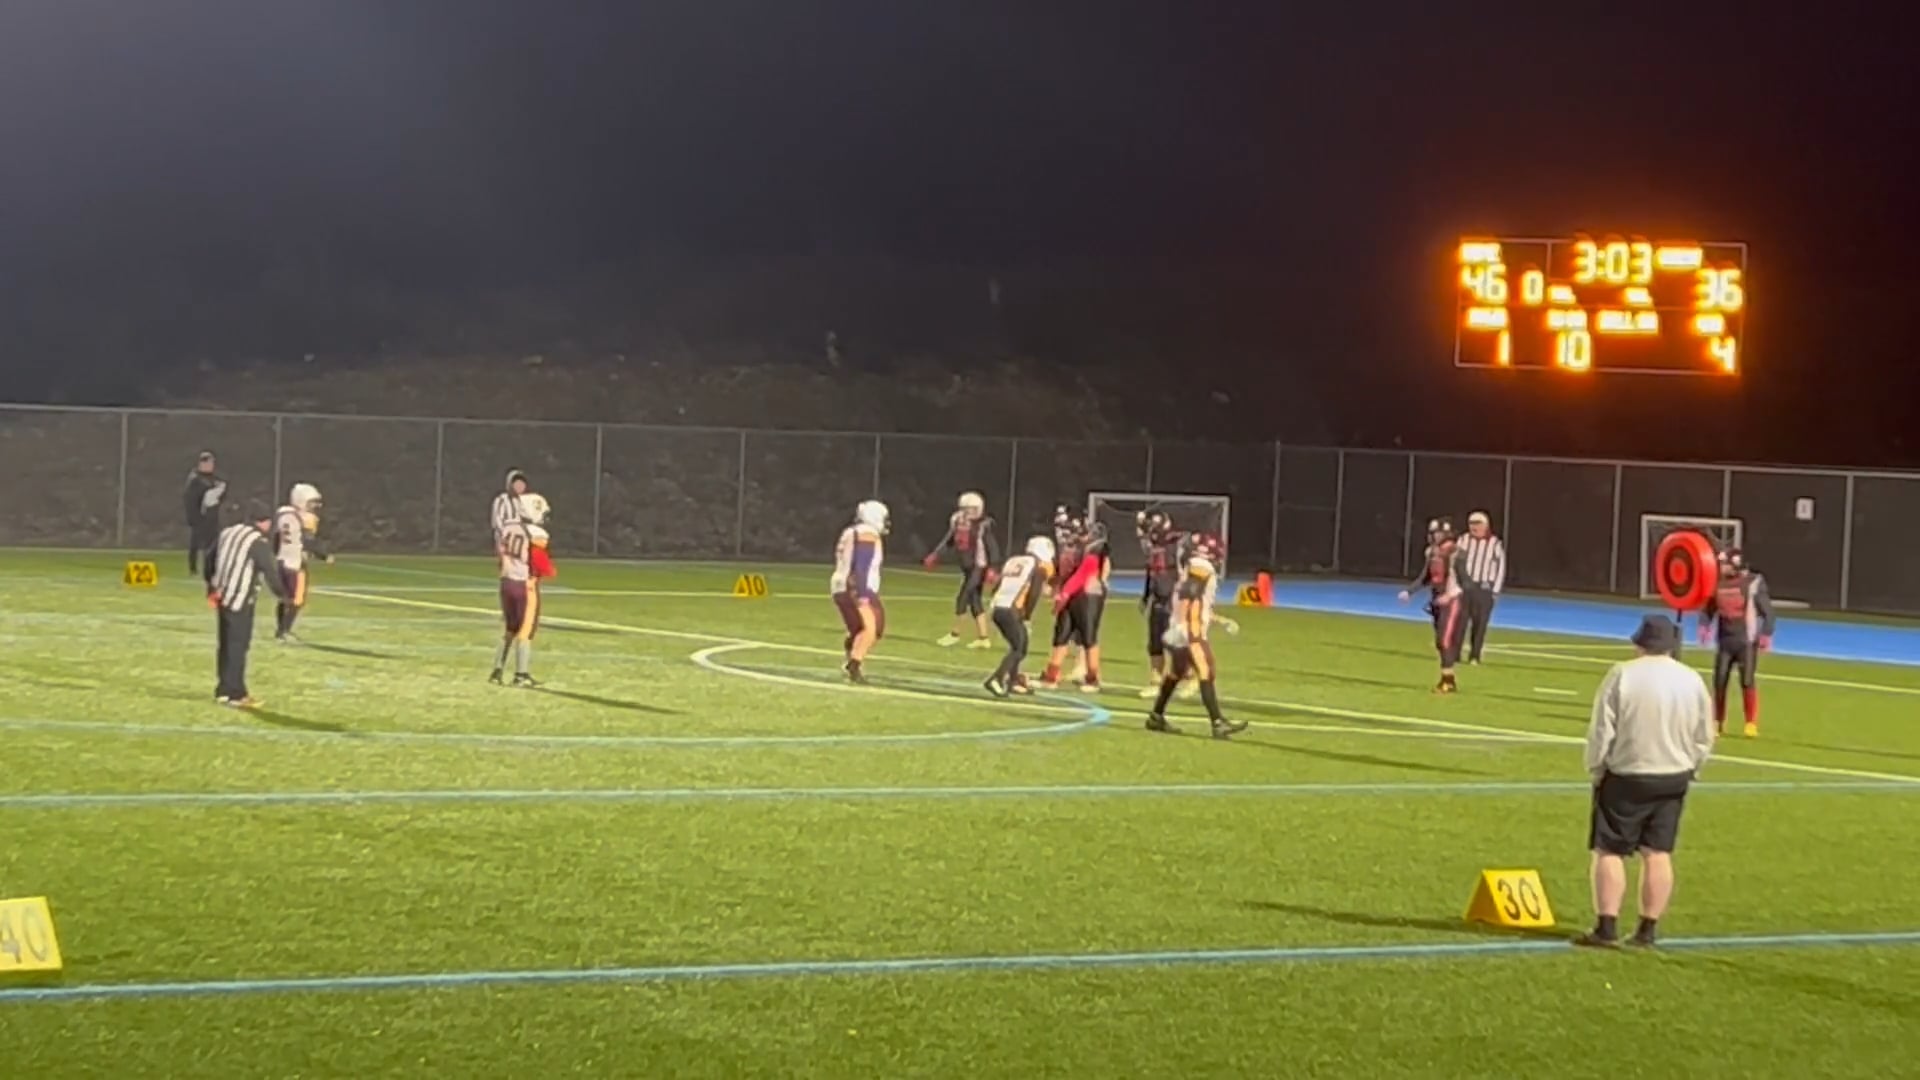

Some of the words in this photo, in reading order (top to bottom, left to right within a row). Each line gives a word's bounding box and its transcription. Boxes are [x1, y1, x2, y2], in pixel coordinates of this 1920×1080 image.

[1575, 242, 1652, 283] 3:03
[1462, 264, 1507, 304] 46
[1523, 271, 1544, 304] 0
[1697, 269, 1743, 310] 36
[1499, 330, 1510, 365] 1
[1556, 330, 1591, 369] 10
[1710, 337, 1735, 371] 4
[132, 563, 154, 584] 20
[743, 574, 765, 596] 10
[1497, 877, 1541, 921] 30
[0, 906, 48, 965] 40
